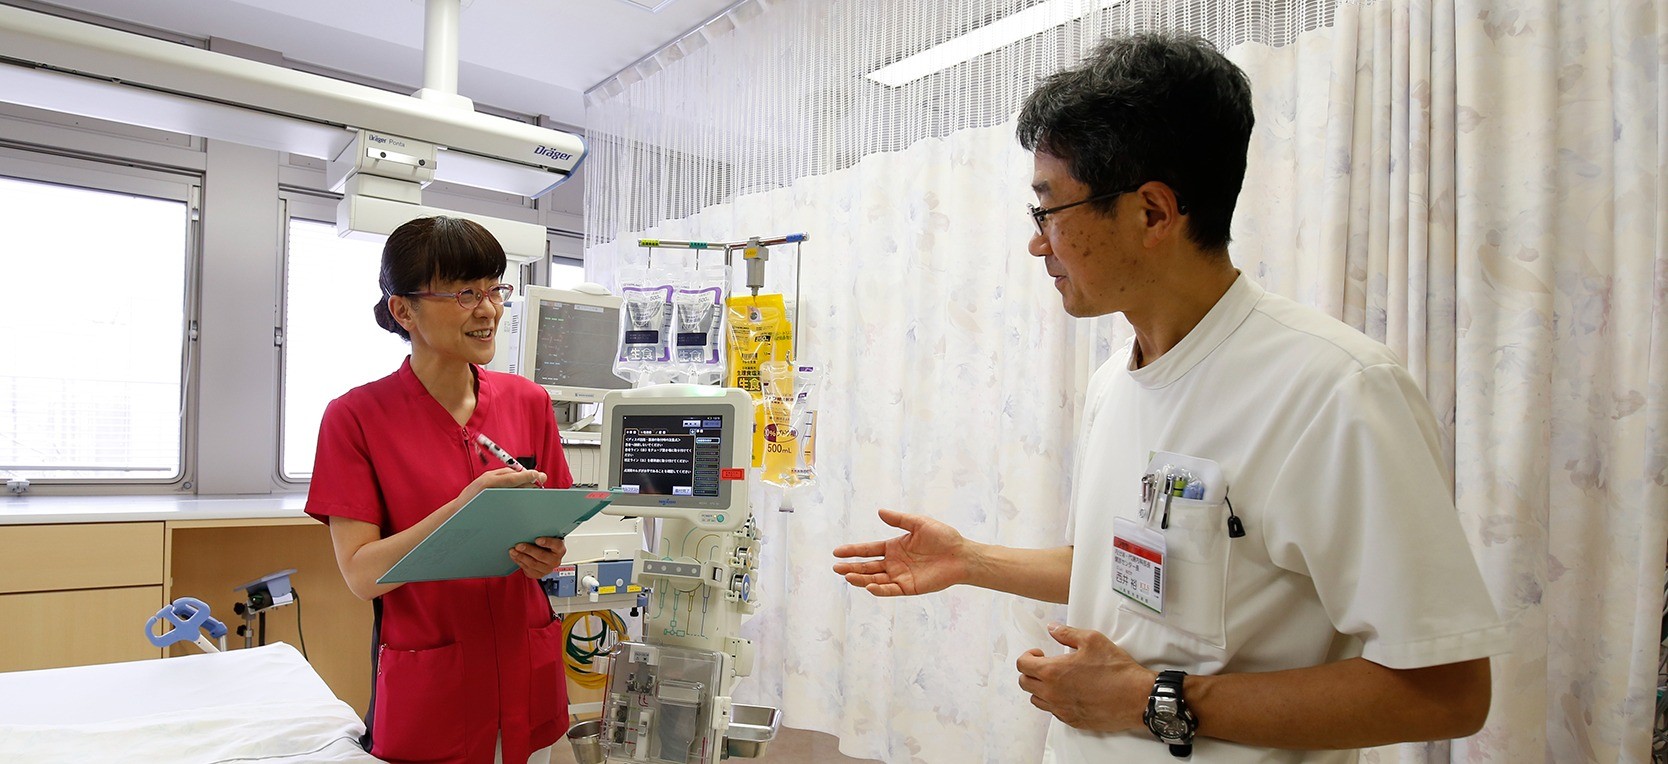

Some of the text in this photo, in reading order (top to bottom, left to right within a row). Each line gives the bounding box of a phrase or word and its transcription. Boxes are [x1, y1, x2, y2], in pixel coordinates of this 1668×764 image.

[369, 135, 406, 148] Dräger Ponta
[534, 145, 573, 161] Dräger
[630, 348, 653, 360] 生食
[678, 350, 702, 362] 生食
[738, 378, 762, 391] 生食
[767, 443, 792, 454] 500mL
